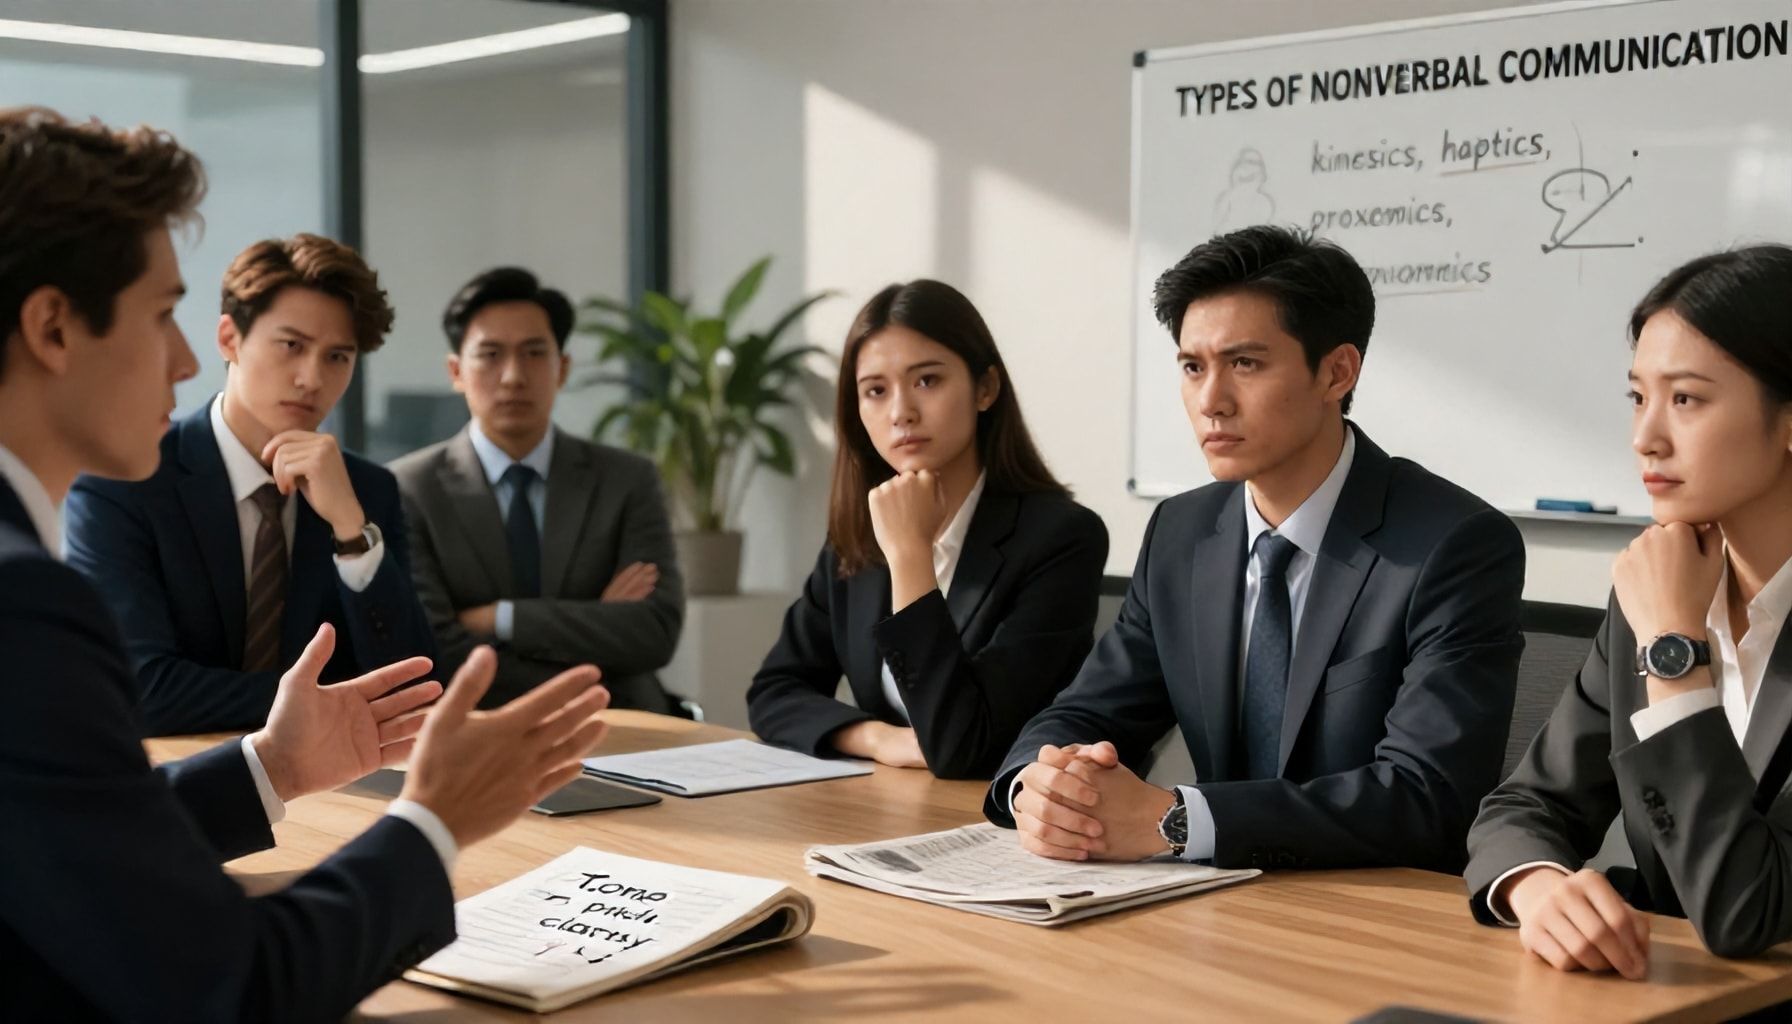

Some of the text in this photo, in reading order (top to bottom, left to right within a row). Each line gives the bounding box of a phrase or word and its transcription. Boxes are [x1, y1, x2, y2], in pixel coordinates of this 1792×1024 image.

[1175, 20, 1788, 117] TYPES OF NONVERBAL COMMUNICATION
[1441, 127, 1550, 171] haptics,
